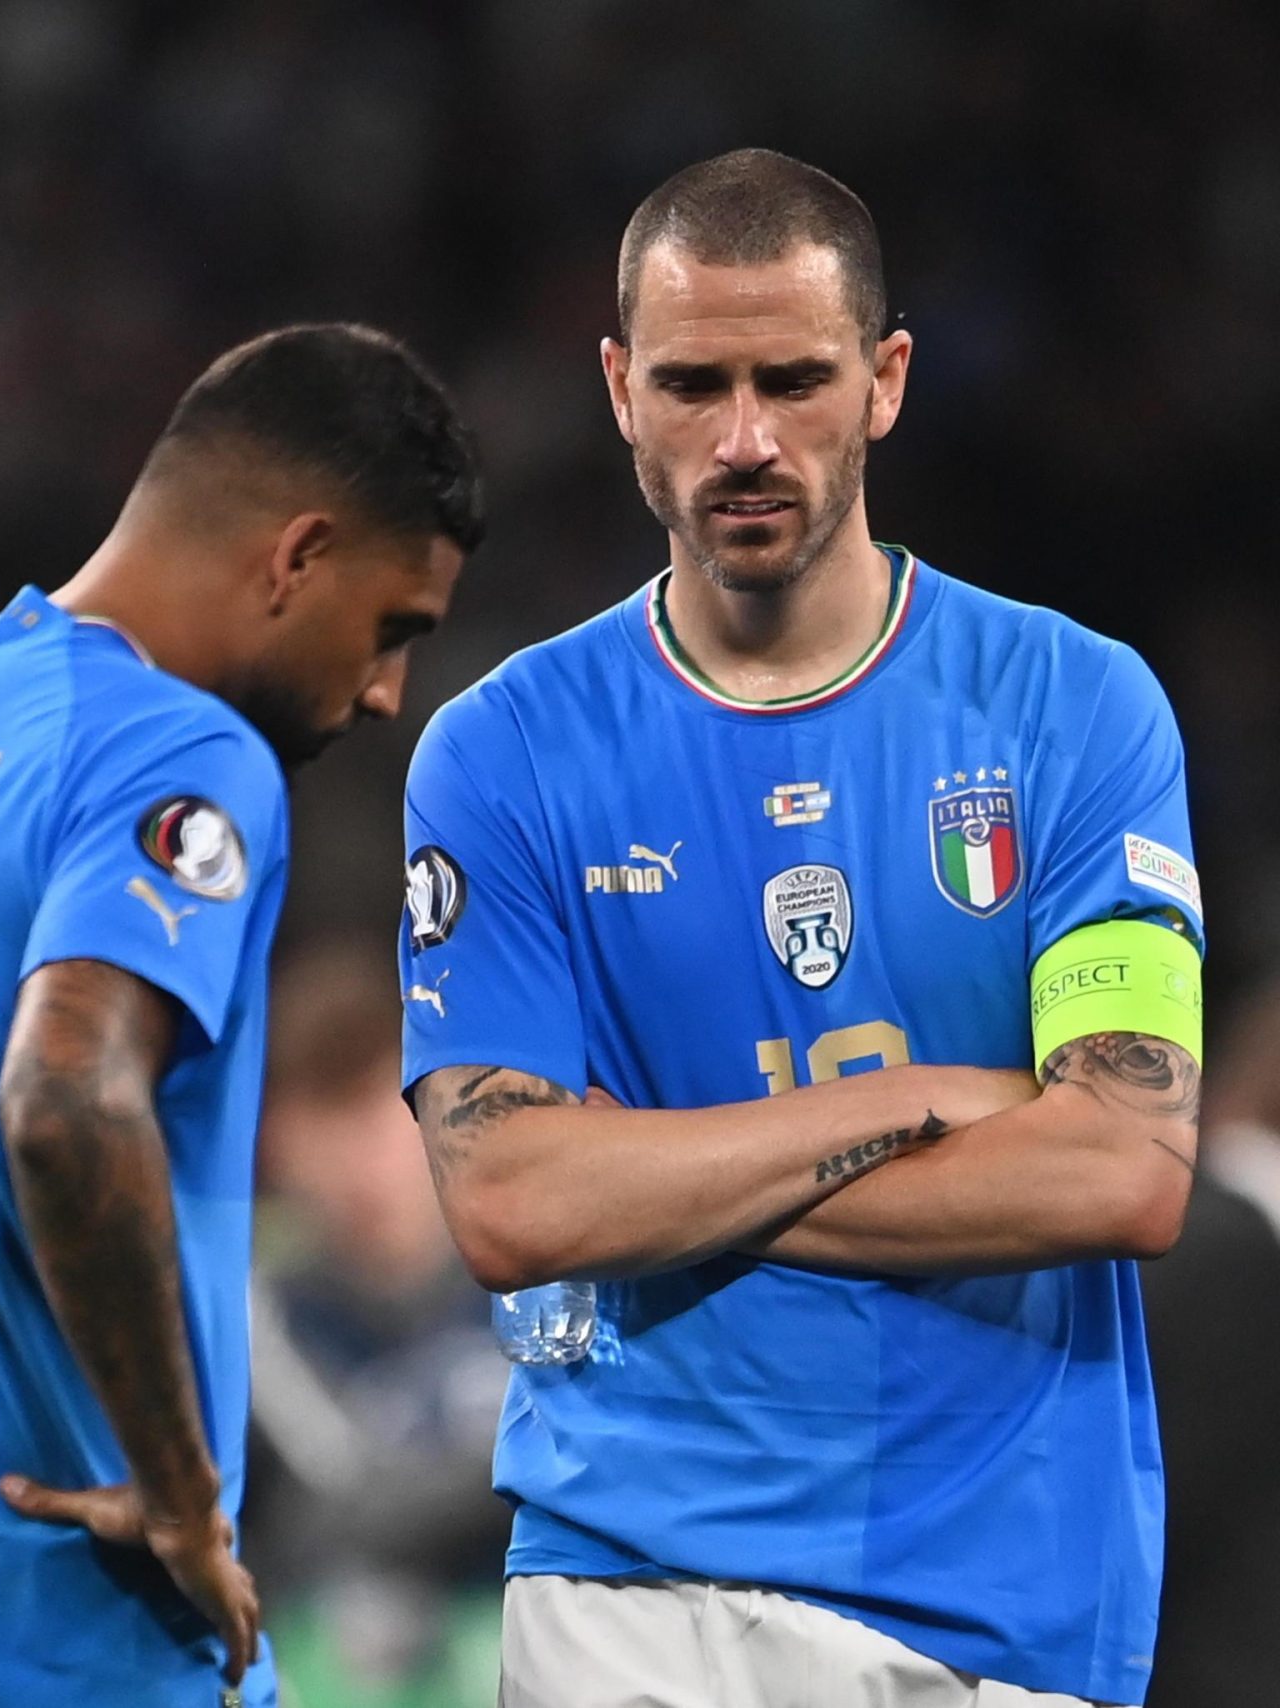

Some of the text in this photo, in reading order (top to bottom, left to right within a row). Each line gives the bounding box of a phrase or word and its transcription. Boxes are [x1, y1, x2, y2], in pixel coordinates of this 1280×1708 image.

[938, 796, 1010, 823] ITALIA
[585, 866, 663, 893] PUMA
[786, 872, 819, 887] UEFA
[776, 885, 835, 903] EUROPEAN
[777, 895, 836, 913] CHAMPIONS
[802, 961, 831, 975] 2020
